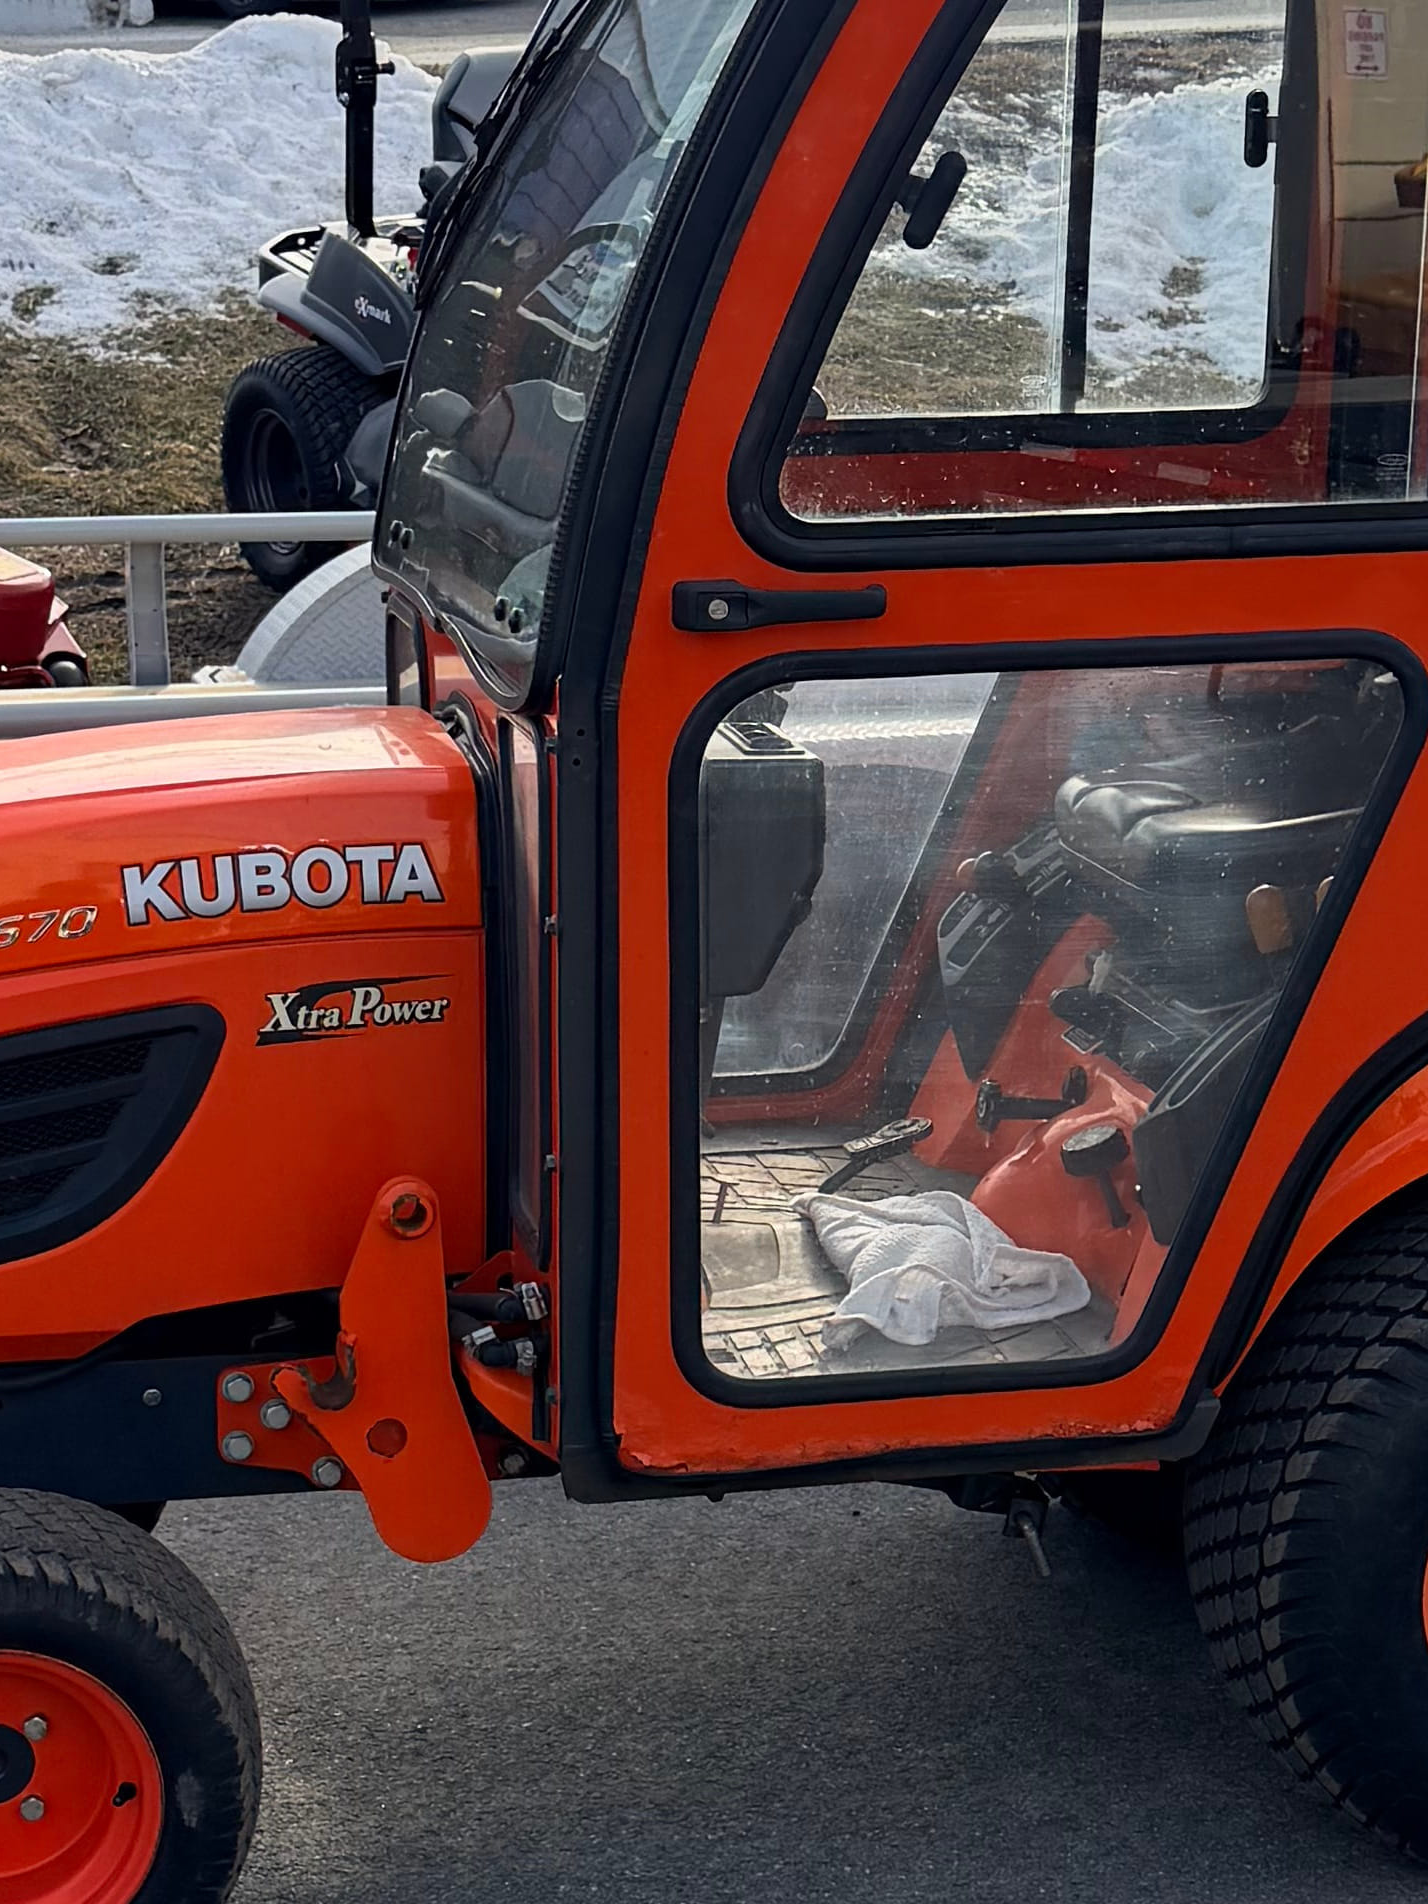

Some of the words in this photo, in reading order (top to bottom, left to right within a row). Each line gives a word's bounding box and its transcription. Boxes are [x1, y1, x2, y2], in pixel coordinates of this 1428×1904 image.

[121, 843, 444, 927] KUBOTA
[258, 992, 340, 1034] Xtra
[349, 984, 450, 1028] Power
